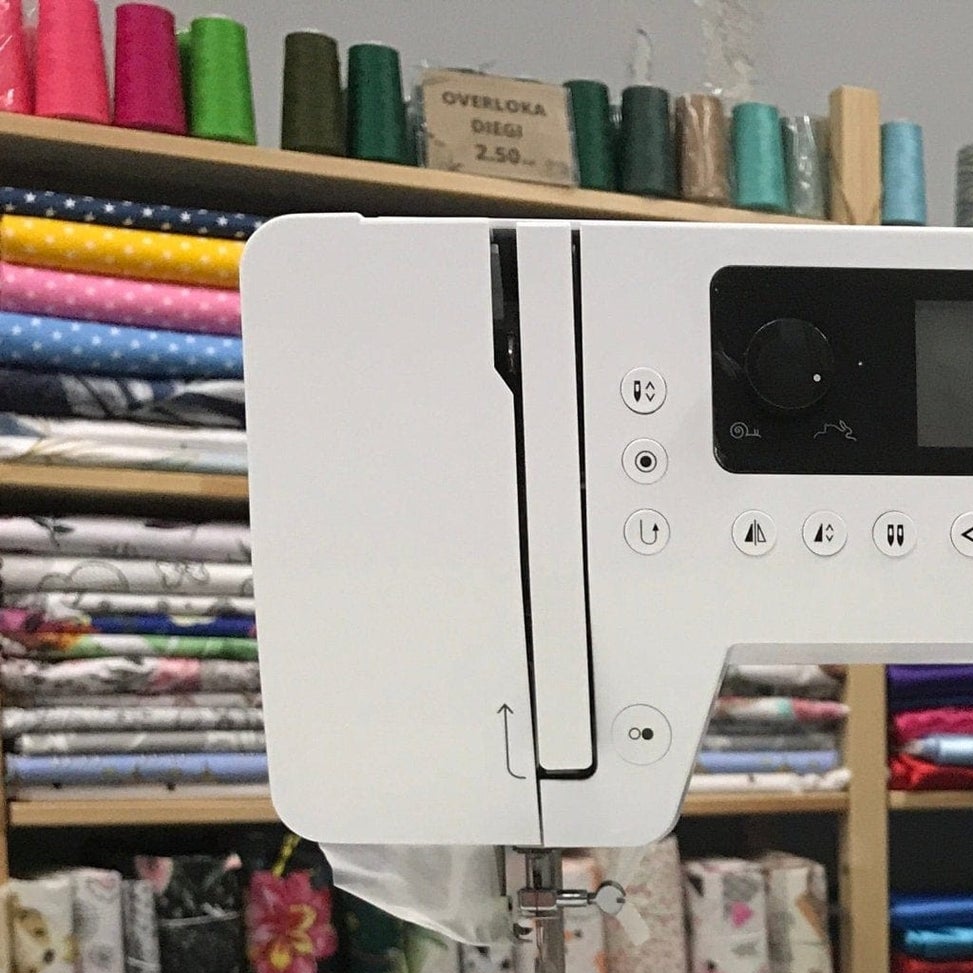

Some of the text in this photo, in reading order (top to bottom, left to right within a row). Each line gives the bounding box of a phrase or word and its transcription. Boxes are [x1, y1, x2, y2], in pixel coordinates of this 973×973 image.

[441, 91, 546, 116] OVERLOKA
[471, 119, 523, 138] DIEGI
[474, 143, 521, 165] 2.50
